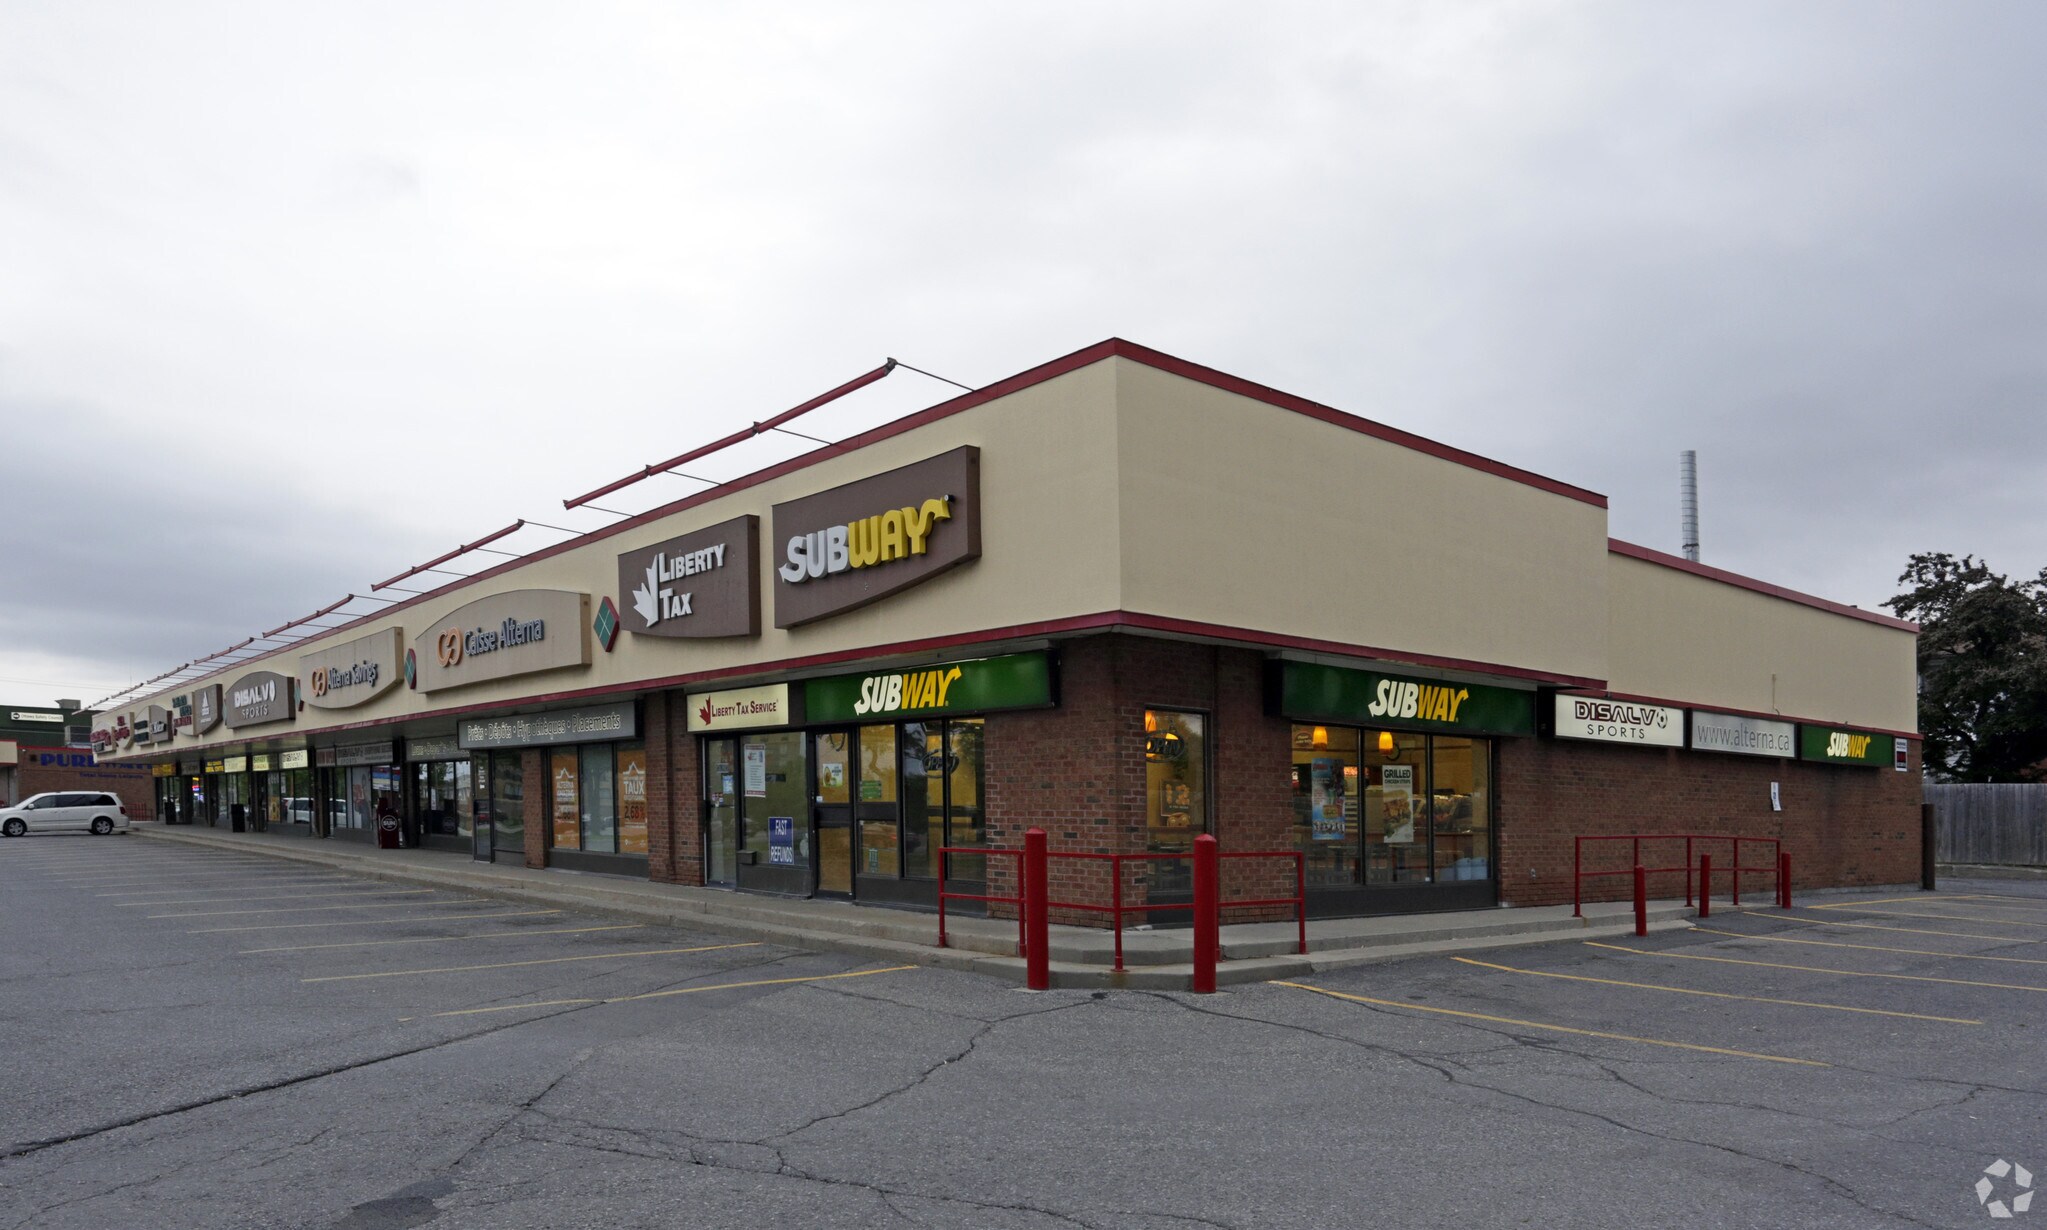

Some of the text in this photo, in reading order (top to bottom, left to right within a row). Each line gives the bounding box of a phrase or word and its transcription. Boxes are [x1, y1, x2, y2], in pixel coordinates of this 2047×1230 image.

[778, 496, 951, 584] SUBWAY
[658, 543, 726, 583] LIBERTY
[659, 588, 693, 620] TAX
[464, 617, 545, 656] Caisse Alterna
[327, 660, 378, 690] Alterna Savings
[853, 665, 962, 716] SUBWAY
[1367, 679, 1469, 722] SUBWAY
[241, 704, 268, 719] SPORTS
[711, 700, 777, 717] LIBERTY TAX SERVICE
[572, 711, 621, 733] Placements
[1586, 723, 1646, 740] SPORTS
[1697, 722, 1790, 752] www.alterna.ca
[1826, 732, 1871, 758] SUBWAY
[1384, 769, 1411, 778] GRILLED
[623, 780, 645, 795] TAUX
[775, 820, 788, 835] FAST
[770, 846, 793, 863] REFUNDS
